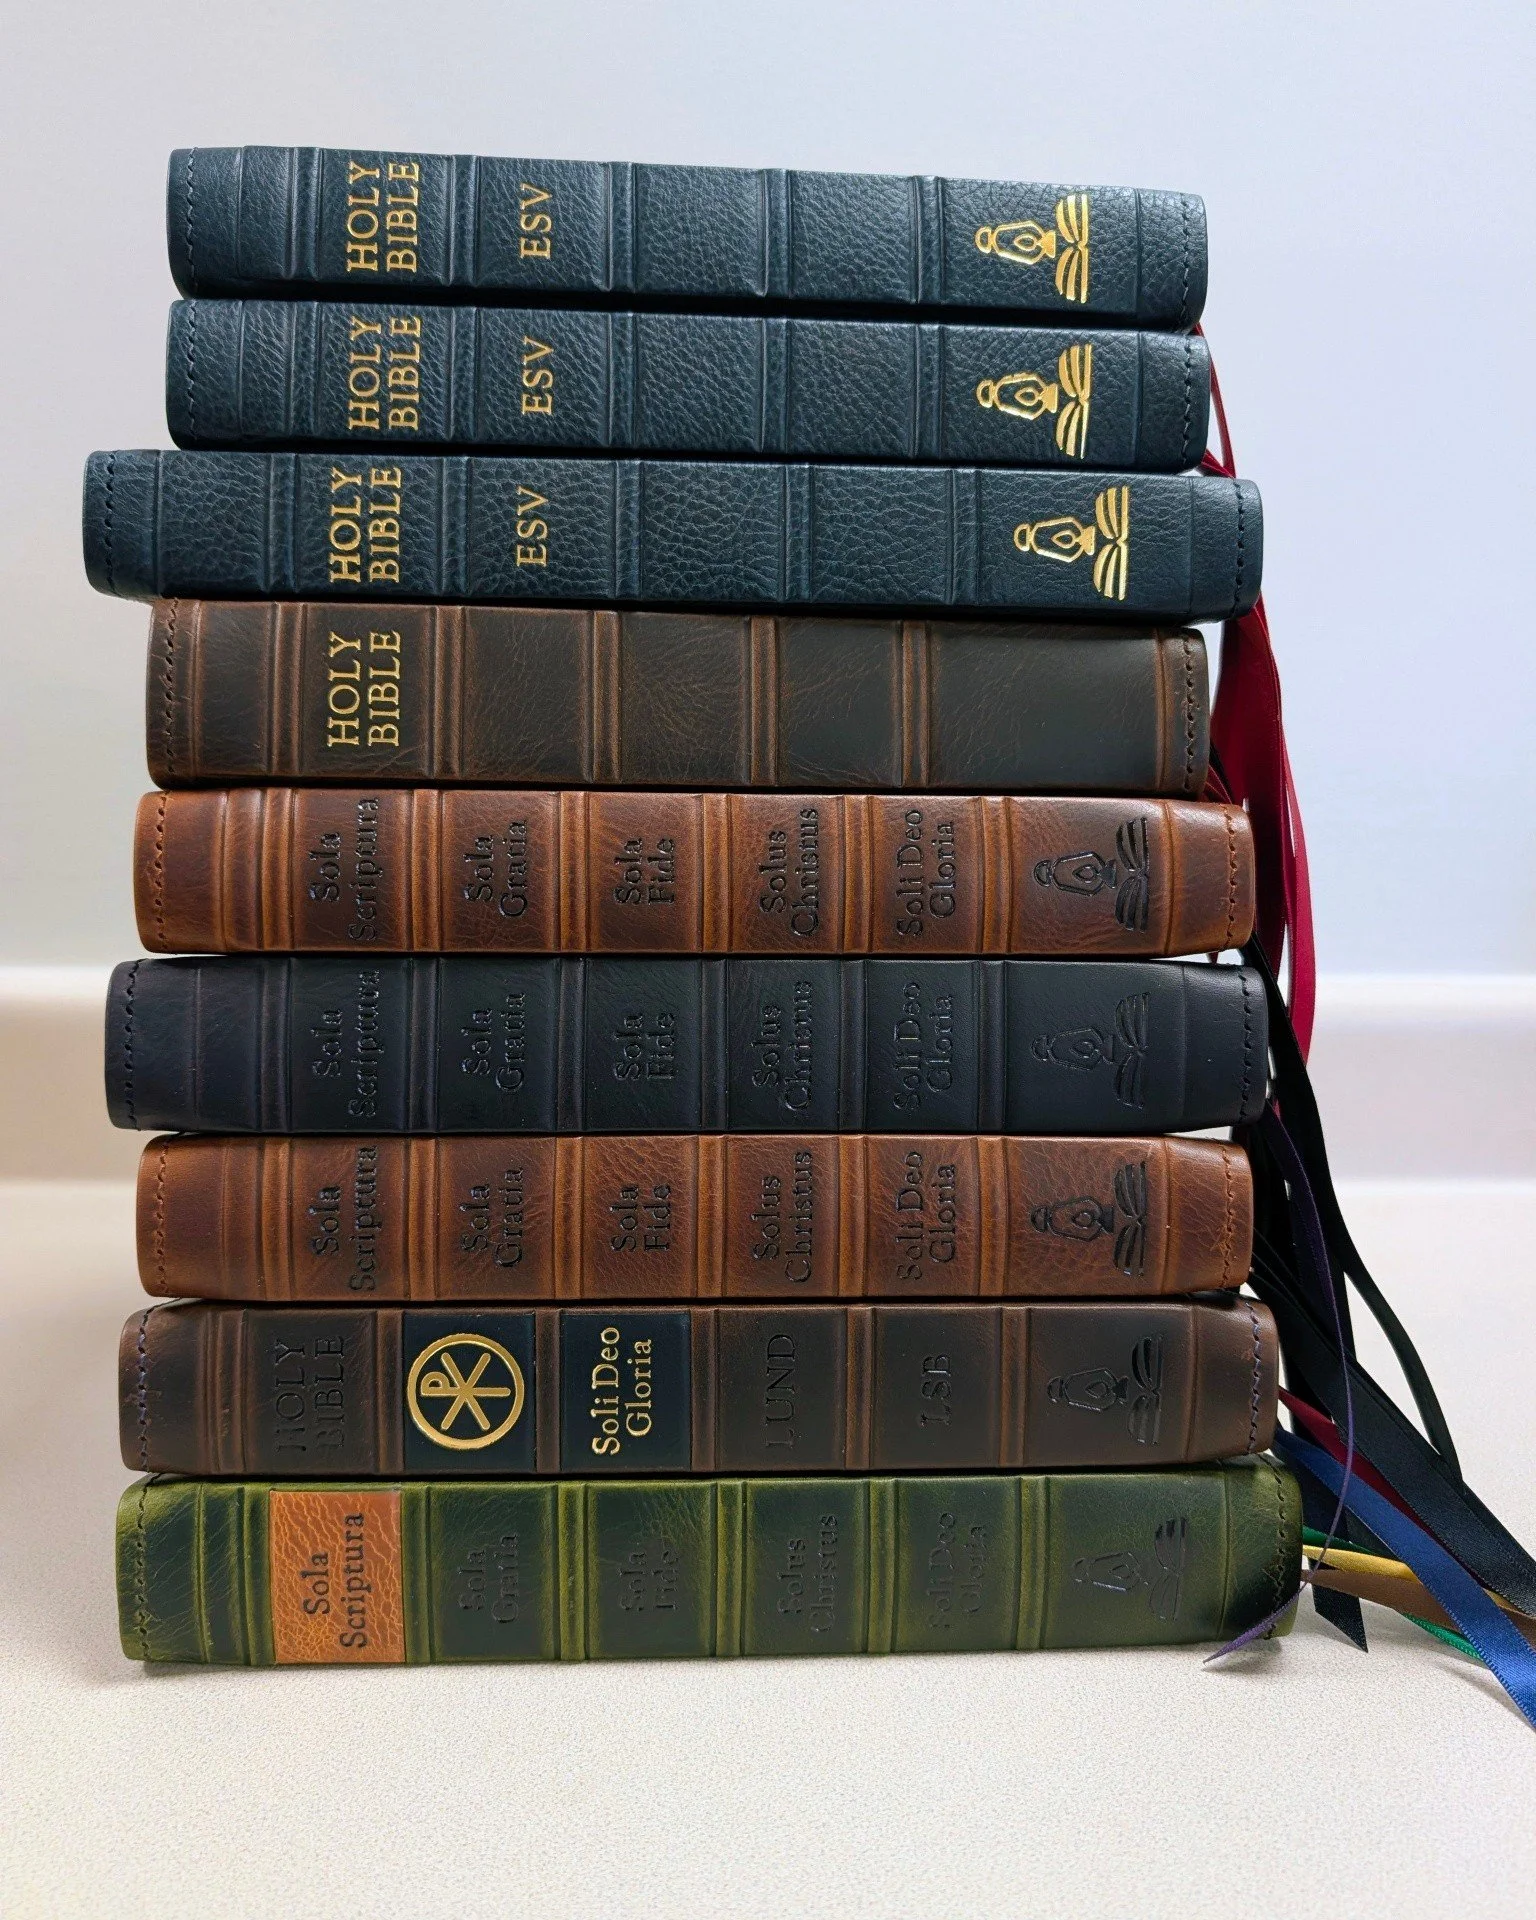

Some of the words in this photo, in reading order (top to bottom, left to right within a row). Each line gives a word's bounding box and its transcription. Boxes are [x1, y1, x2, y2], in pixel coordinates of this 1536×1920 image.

[346, 162, 380, 272] HOLY
[386, 162, 420, 273] BIBLE
[520, 182, 552, 260] ESV
[348, 316, 382, 430] HOLY
[388, 316, 421, 431] BIBLE
[521, 336, 554, 415] ESV
[328, 466, 363, 583] HOLY
[368, 467, 402, 583] BIBLE
[516, 485, 549, 567] ESV
[326, 631, 361, 747] HOLY
[368, 630, 401, 747] BIBLE
[309, 831, 342, 902] Sola
[349, 798, 383, 941] Scriptura
[463, 835, 494, 901] Sola
[501, 820, 527, 917] Gratia
[614, 837, 642, 906] Sola
[647, 837, 675, 906] Fide
[759, 830, 787, 914] Solus
[791, 808, 819, 937] Christus
[896, 809, 924, 869] Deo
[929, 821, 956, 919] Gloria
[897, 874, 924, 937] Soli
[311, 1008, 343, 1077] Sola
[348, 969, 384, 1117] Scriptura
[460, 1008, 493, 1075] Sola
[497, 992, 526, 1092] Gratia
[613, 1012, 643, 1081] Sola
[646, 1012, 675, 1080] Fide
[752, 1003, 782, 1087] Solus
[782, 980, 814, 1111] Christus
[893, 982, 922, 1041] Deo
[926, 995, 953, 1092] Gloria
[893, 1050, 921, 1109] Soli
[309, 1184, 342, 1255] Sola
[349, 1144, 382, 1291] Scriptura
[460, 1183, 490, 1251] Sola
[493, 1167, 524, 1268] Gratia
[609, 1183, 640, 1252] Sola
[643, 1184, 671, 1251] Fide
[751, 1175, 781, 1261] Solus
[785, 1152, 813, 1283] Christus
[896, 1151, 923, 1212] Deo
[929, 1163, 955, 1263] Gloria
[895, 1219, 924, 1280] Soli
[273, 1341, 305, 1452] HOLY
[311, 1335, 344, 1449] BIBLE
[592, 1327, 620, 1388] Deo
[626, 1338, 652, 1438] Gloria
[764, 1333, 795, 1449] LUND
[919, 1353, 952, 1428] LSB
[591, 1398, 620, 1455] Soli
[303, 1551, 330, 1616] Sola
[339, 1512, 372, 1648] Scriptura
[457, 1549, 488, 1610] Sola
[618, 1550, 646, 1612] Sola
[777, 1537, 807, 1616] Solus
